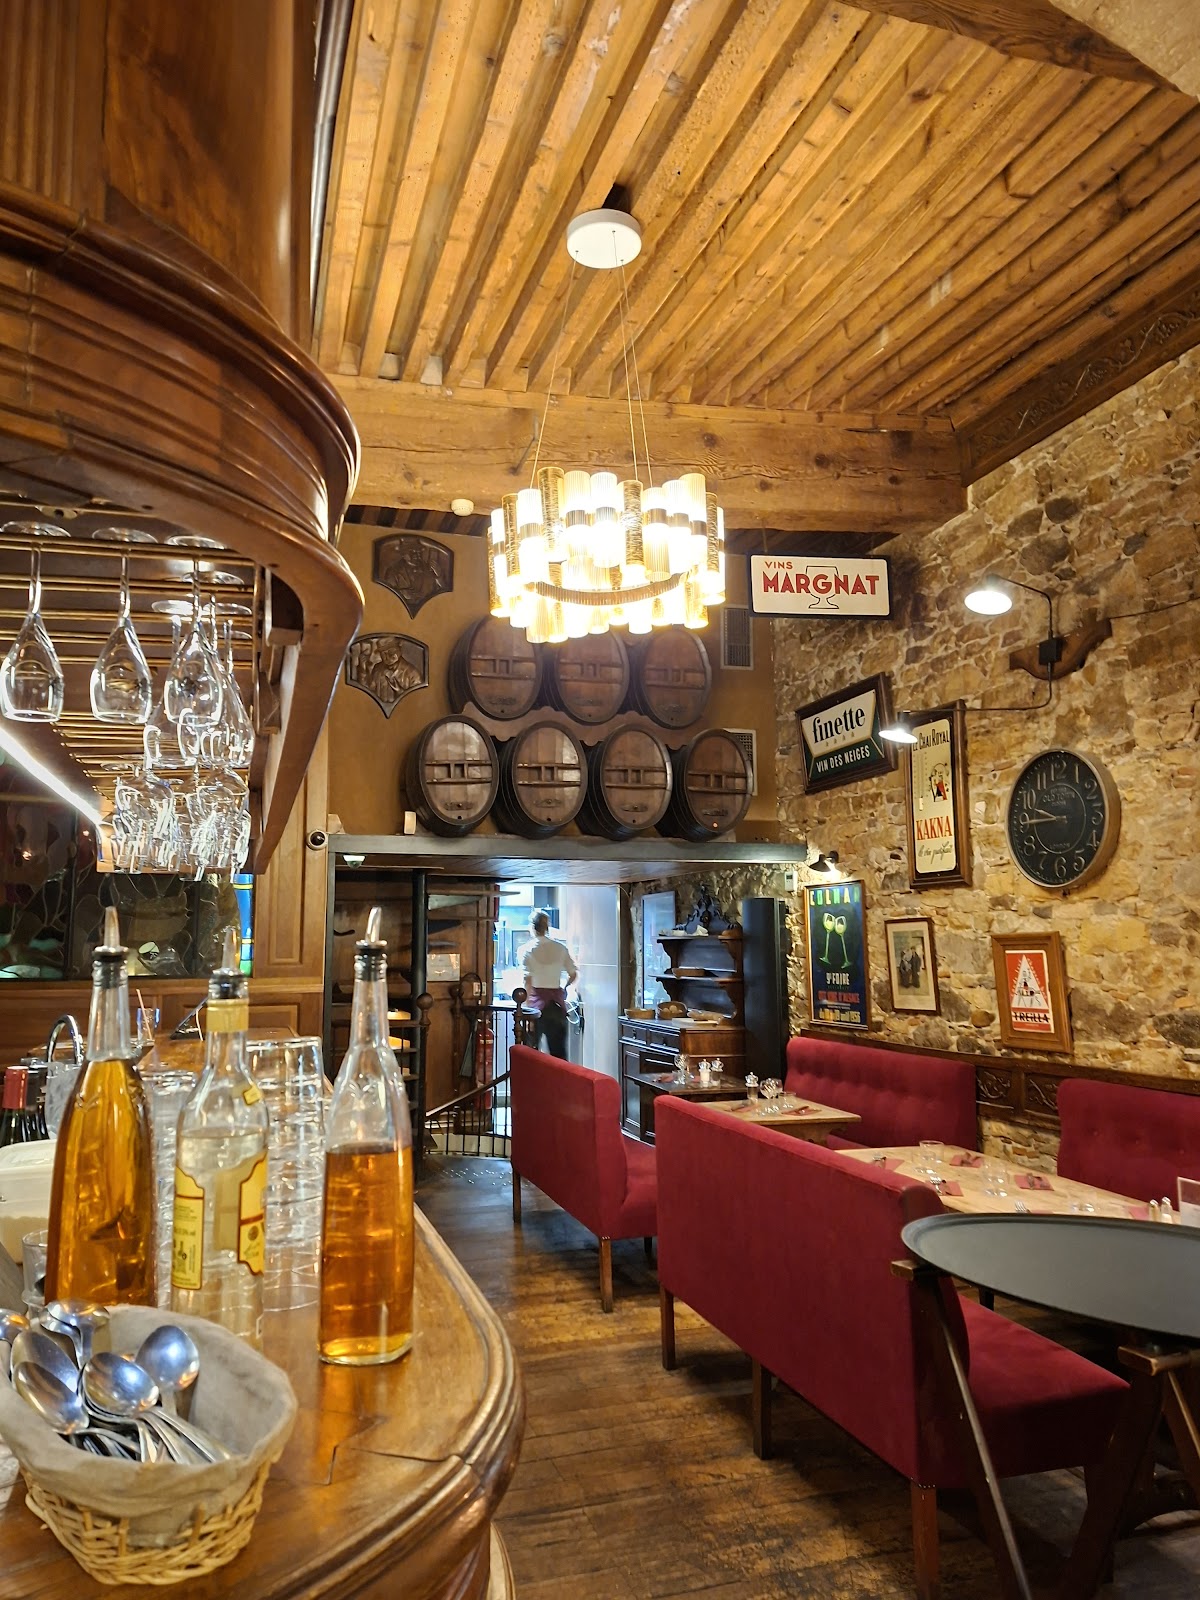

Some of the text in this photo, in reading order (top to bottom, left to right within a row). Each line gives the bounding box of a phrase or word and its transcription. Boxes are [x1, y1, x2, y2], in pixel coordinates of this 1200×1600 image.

[765, 561, 793, 570] VINS
[762, 571, 880, 595] MARGNAT
[813, 708, 866, 744] finette
[816, 745, 870, 773] VIN DES NEIGES
[1051, 759, 1067, 781] 12
[1037, 772, 1047, 790] 11
[1085, 779, 1098, 799] 2
[1022, 788, 1037, 810] 10
[1019, 812, 1030, 833] 9
[1092, 803, 1104, 825] 3
[916, 815, 953, 841] KAKNA
[1023, 835, 1036, 856] 8
[1086, 829, 1100, 851] 4
[1038, 851, 1048, 870] 7
[1055, 856, 1067, 878] 6
[1073, 849, 1085, 872] 5
[810, 886, 860, 906] COLMAR
[832, 972, 850, 986] FOIRE
